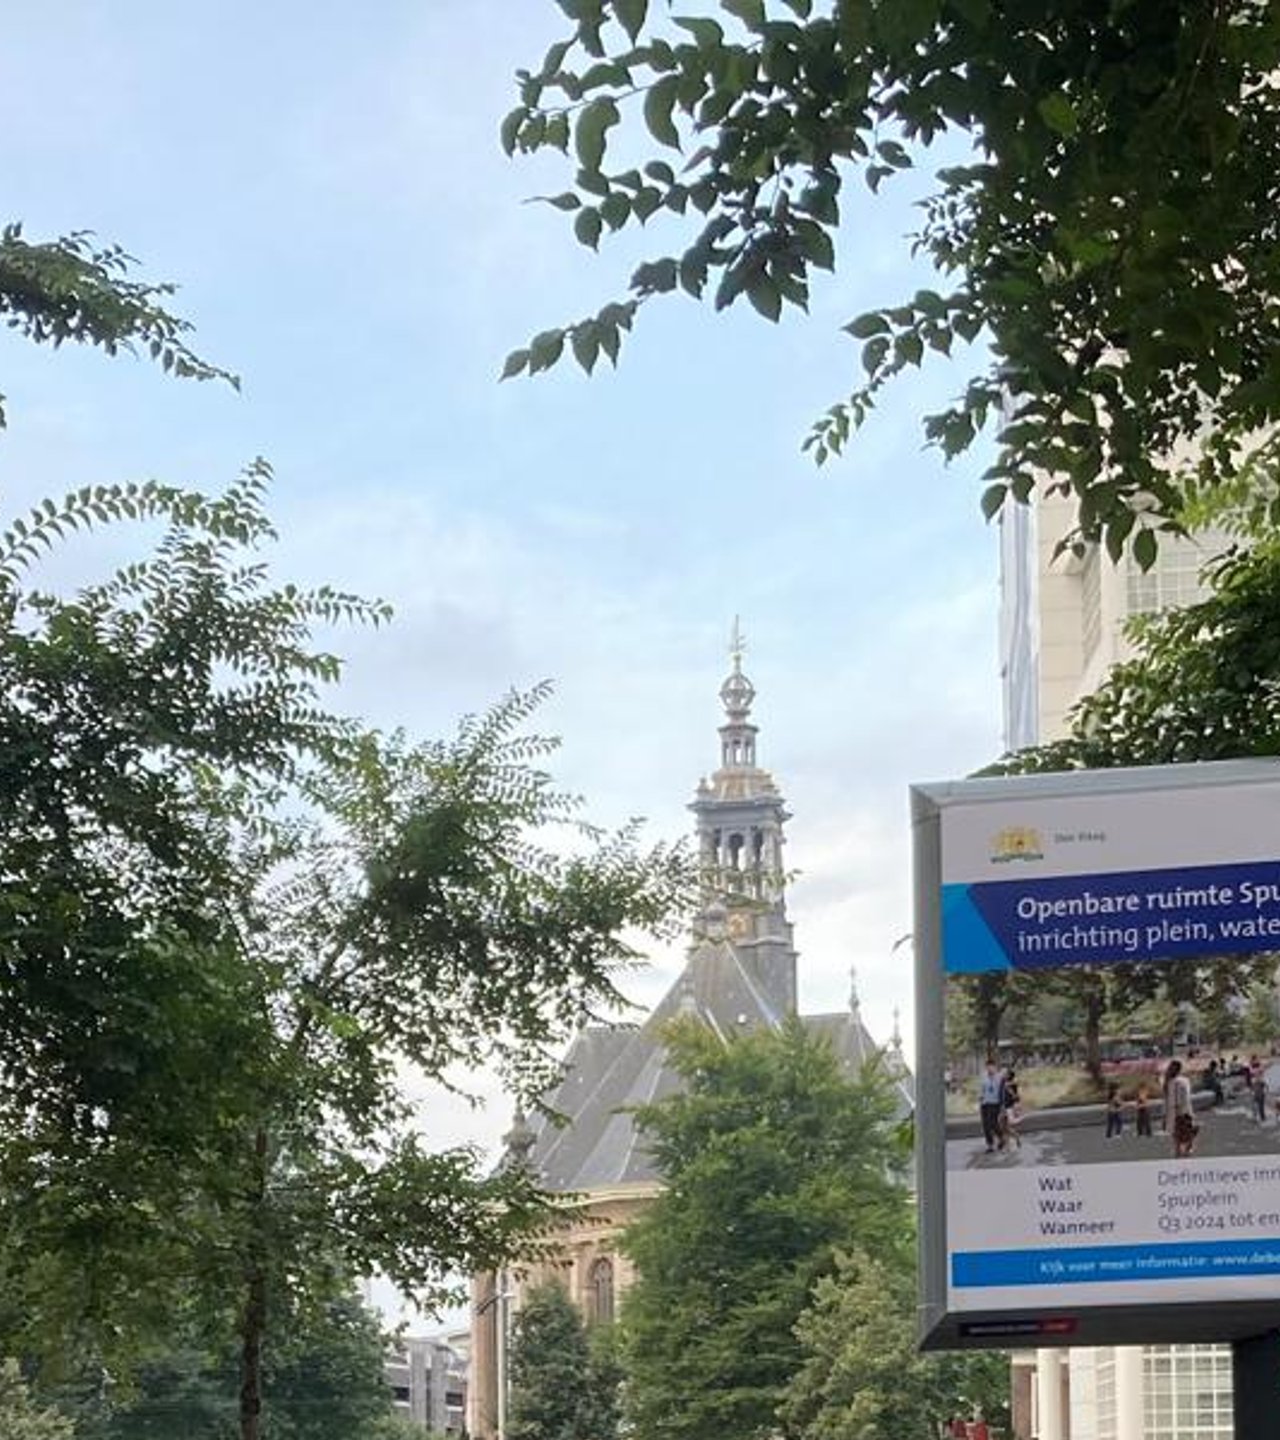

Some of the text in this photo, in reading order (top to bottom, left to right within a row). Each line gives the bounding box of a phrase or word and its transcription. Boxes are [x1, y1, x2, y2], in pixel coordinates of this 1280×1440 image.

[1018, 892, 1140, 923] Openbare
[1147, 884, 1233, 910] ruimte
[1019, 922, 1139, 952] inrichting
[1147, 918, 1215, 945] plein,
[1039, 1177, 1073, 1192] Wat
[1158, 1168, 1250, 1186] Definitieve
[1039, 1191, 1239, 1214] Waar Spuiplein
[1040, 1220, 1115, 1235] Wanneer
[1158, 1215, 1181, 1233] Q3
[1185, 1213, 1225, 1231] 2024
[1230, 1212, 1254, 1227] tot
[1260, 1212, 1280, 1226] en
[1136, 1254, 1208, 1269] informatie:
